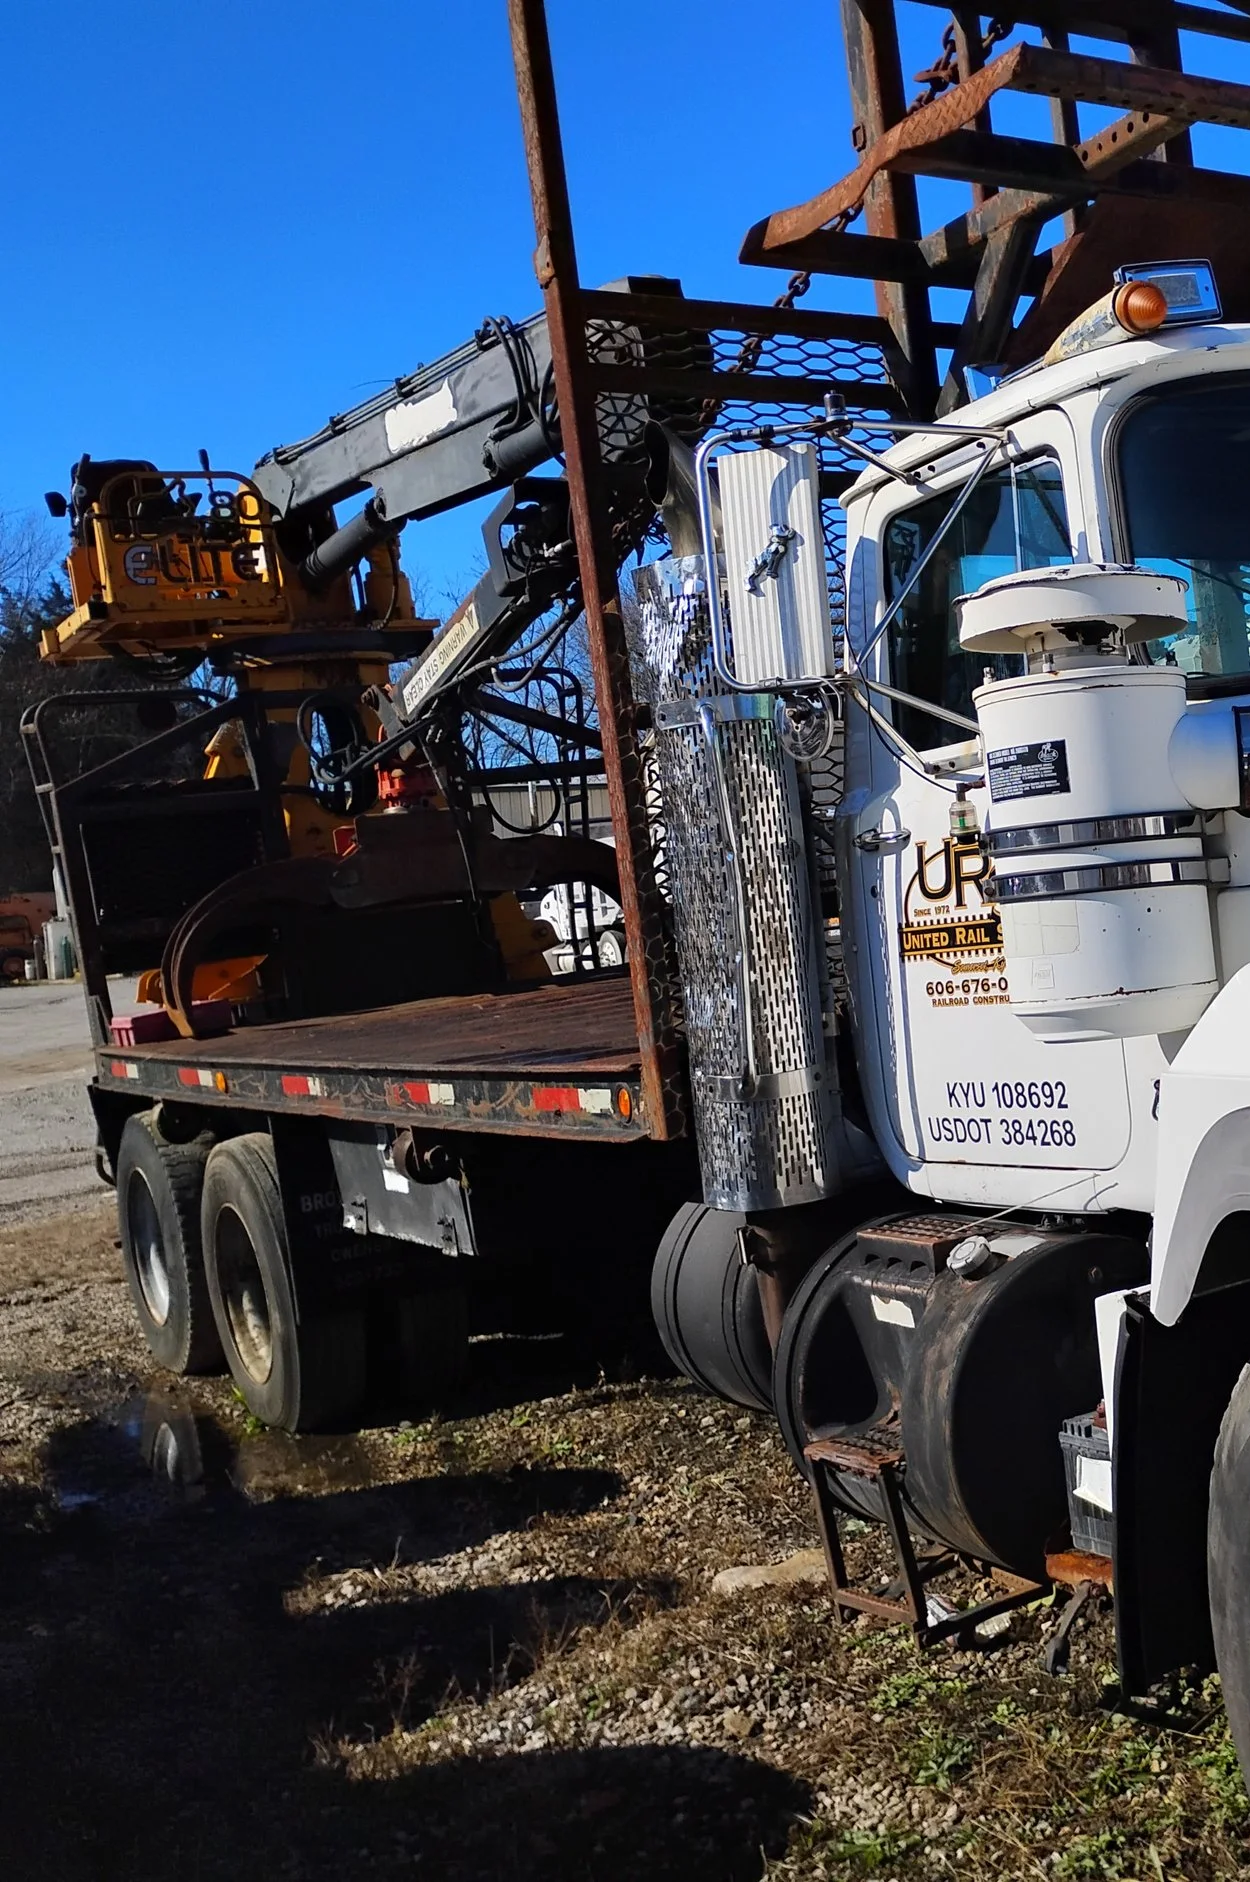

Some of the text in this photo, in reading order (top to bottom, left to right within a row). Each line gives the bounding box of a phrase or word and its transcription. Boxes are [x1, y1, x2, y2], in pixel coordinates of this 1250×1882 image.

[405, 624, 467, 708] WARNING STAY CLEAR
[934, 905, 951, 915] 1972
[903, 931, 949, 950] UNITED
[955, 927, 990, 945] RAIL
[926, 977, 1009, 996] 606-676-0
[932, 994, 1010, 1008] RAILROAD CONSTRU
[946, 1081, 1069, 1109] KYU 108692
[928, 1117, 1077, 1147] USDOT 384268
